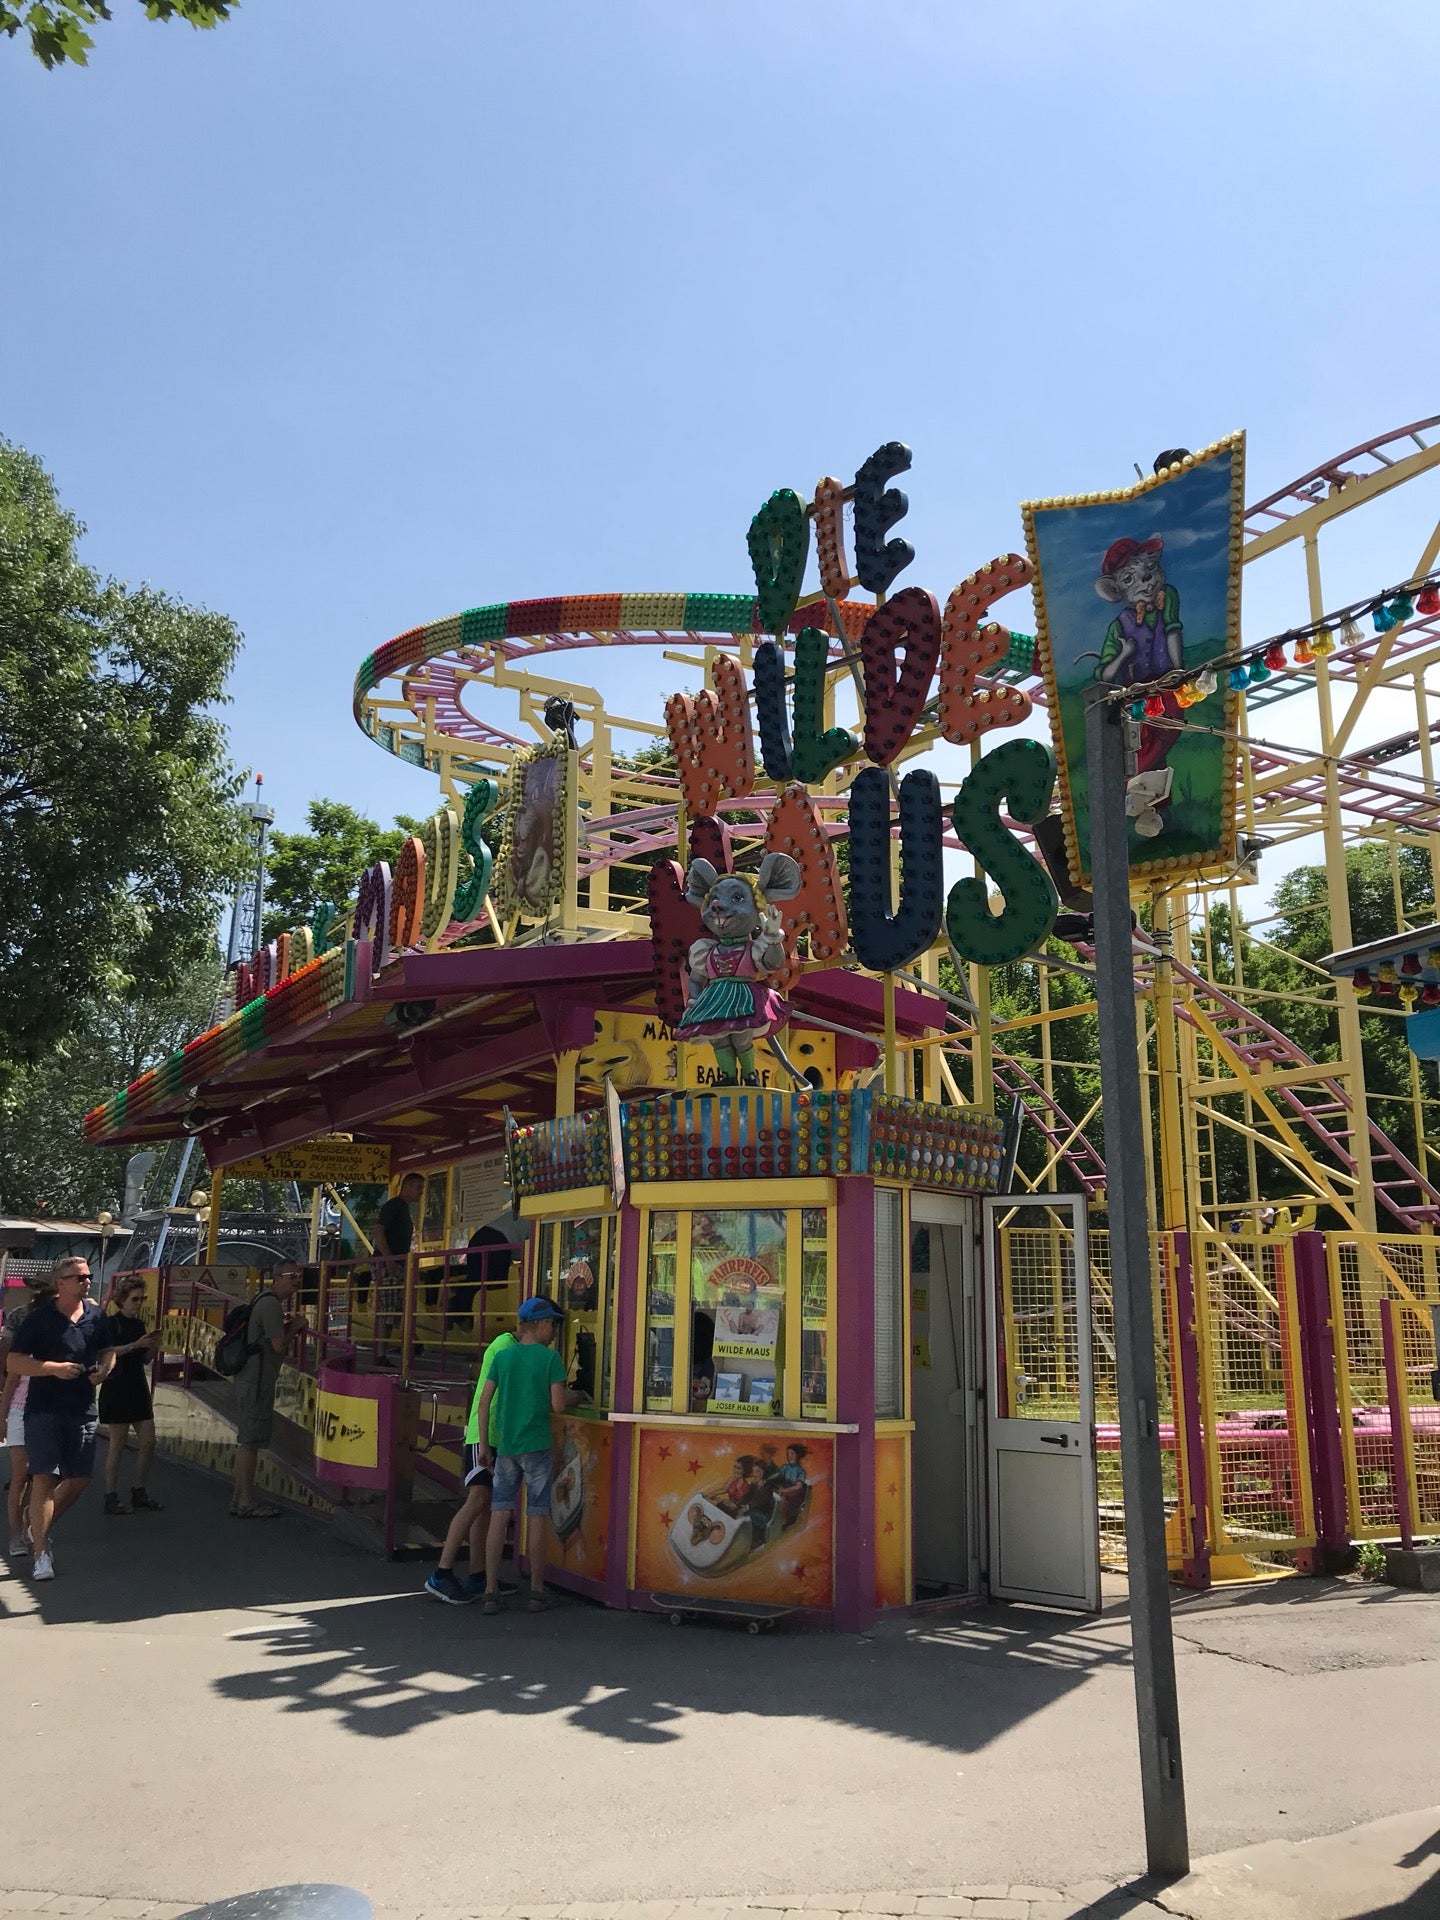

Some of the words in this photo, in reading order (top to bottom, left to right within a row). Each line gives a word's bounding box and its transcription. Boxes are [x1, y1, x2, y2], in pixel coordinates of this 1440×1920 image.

[746, 441, 915, 633] DIE
[665, 552, 1035, 818] WILDE
[708, 1257, 771, 1289] FAHRPREIS
[718, 1344, 744, 1355] WILDE
[745, 1346, 771, 1357] MAUS
[715, 1401, 735, 1411] JOSEF
[737, 1403, 760, 1413] HADER
